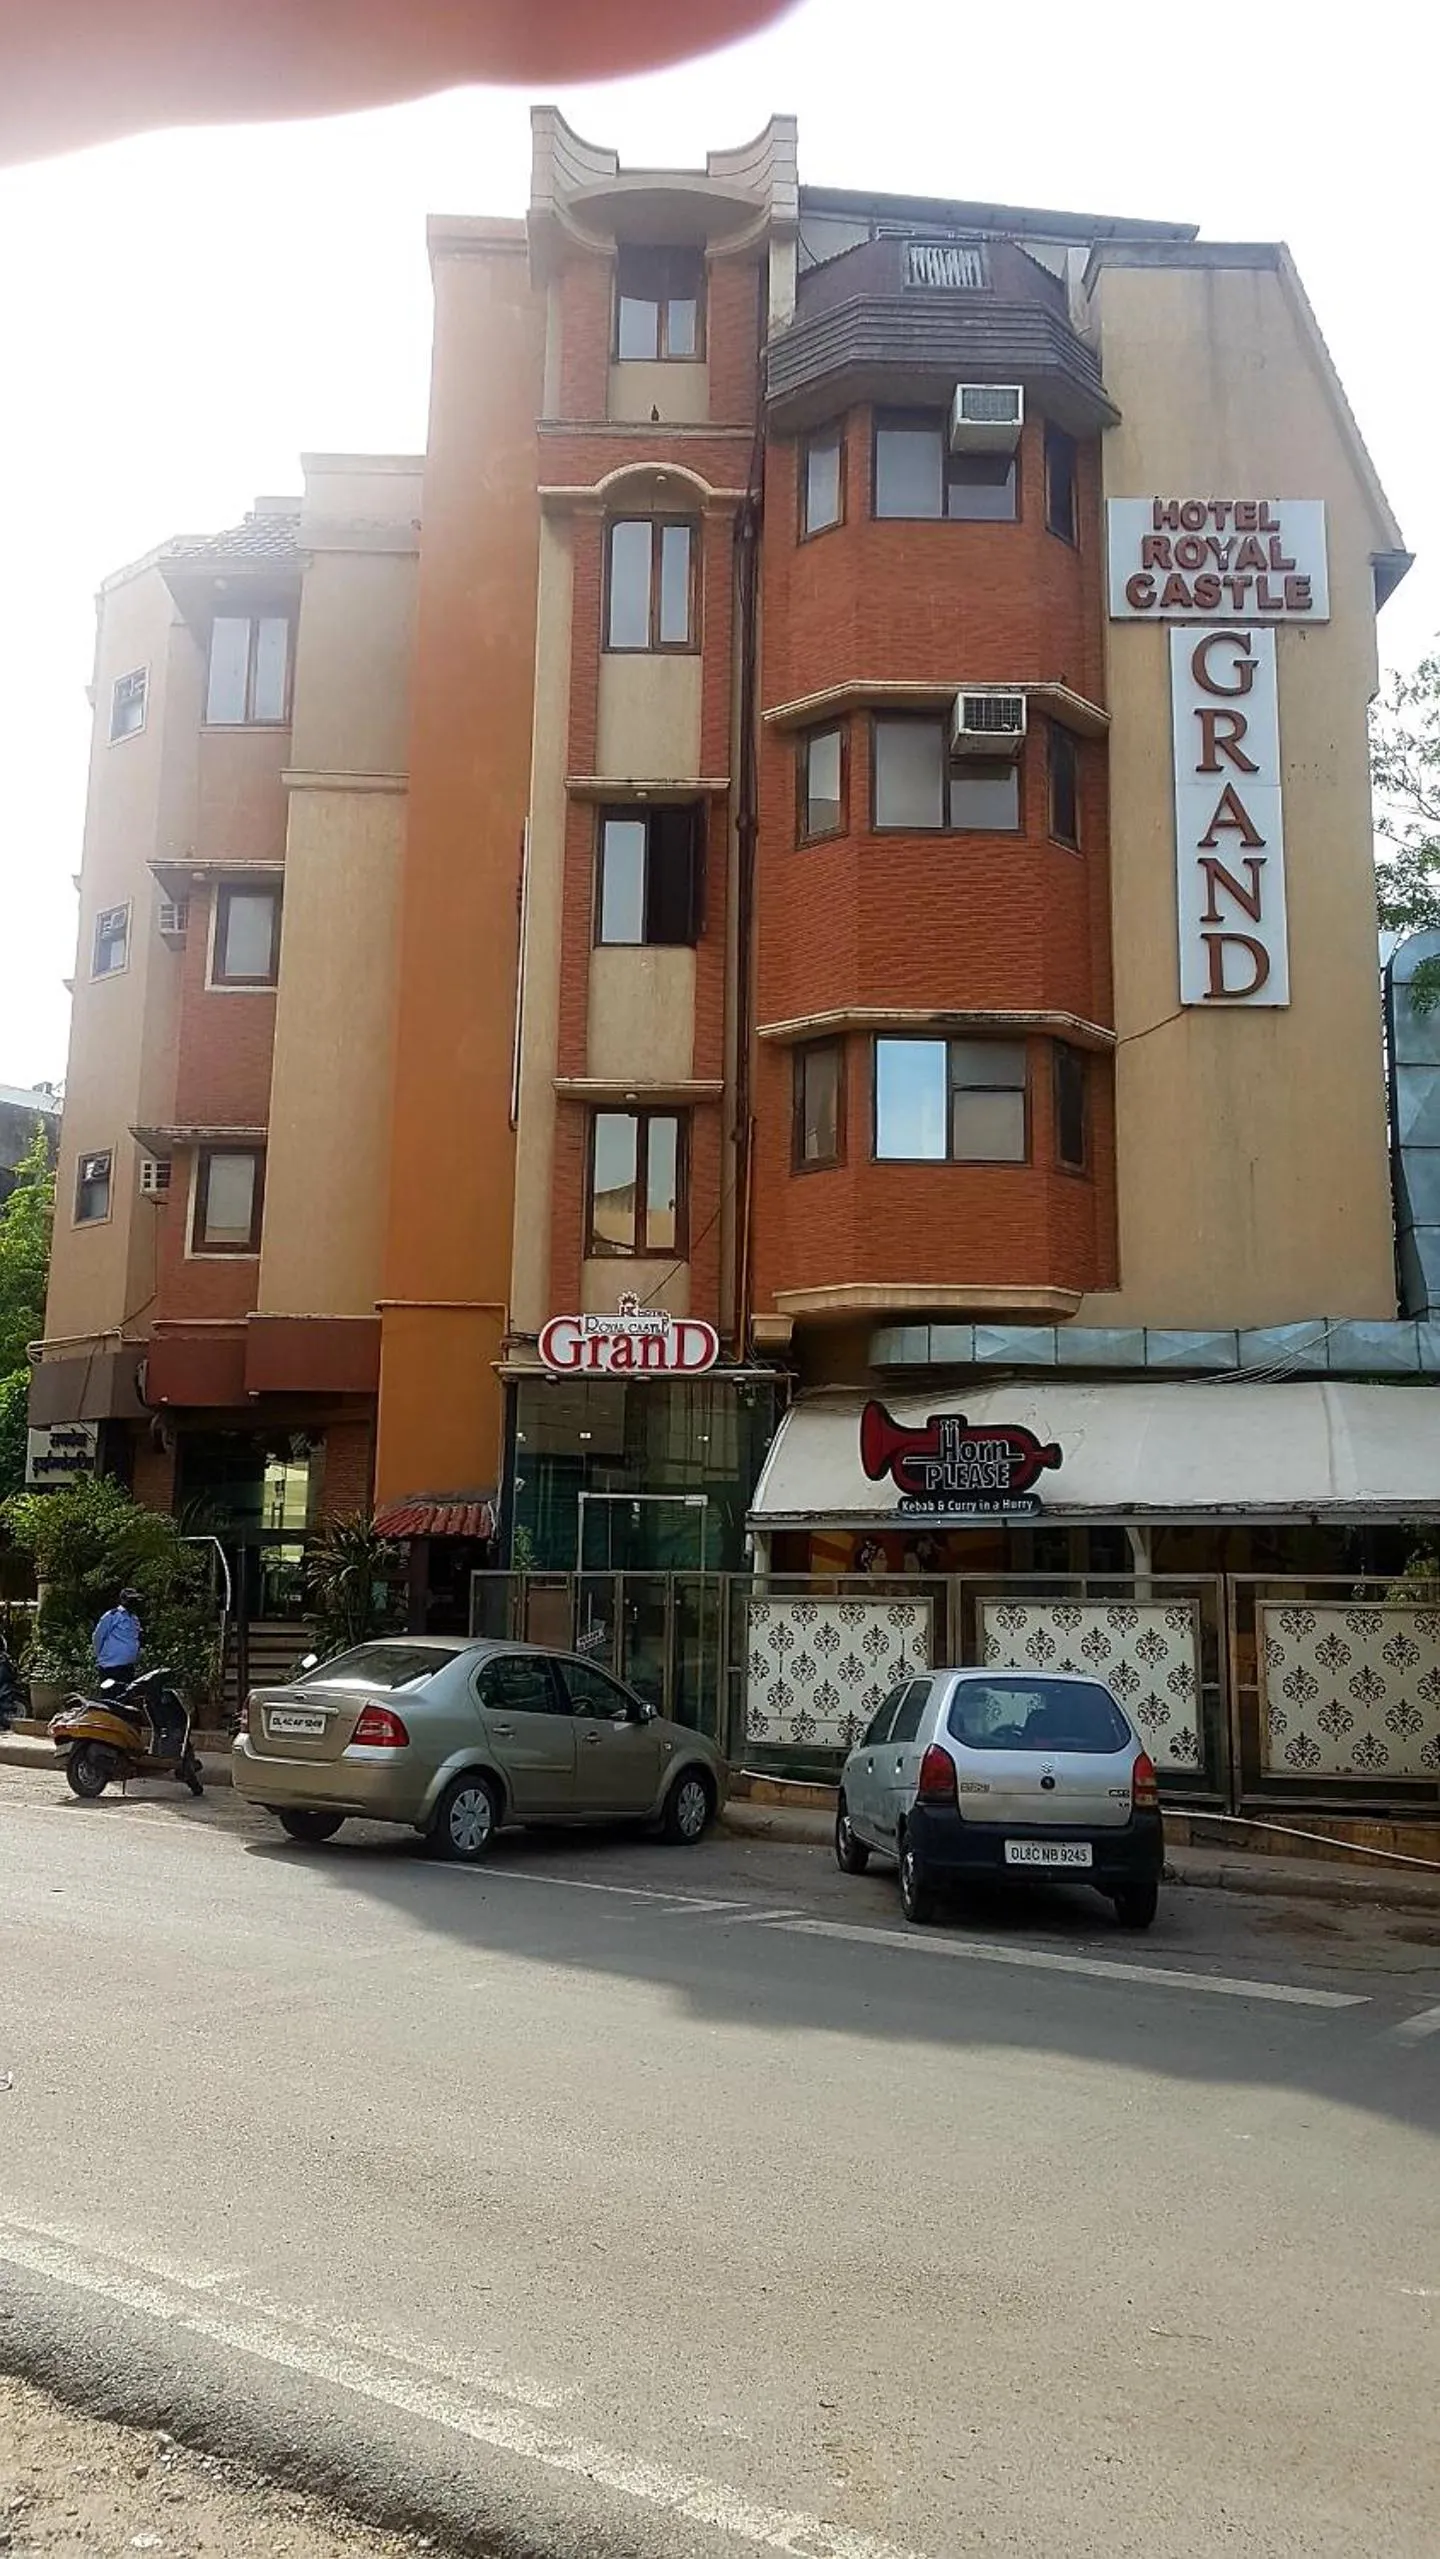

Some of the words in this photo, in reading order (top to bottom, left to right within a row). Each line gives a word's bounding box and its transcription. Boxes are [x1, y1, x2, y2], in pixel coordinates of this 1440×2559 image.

[1152, 501, 1280, 532] HOTEL
[1141, 533, 1296, 570] ROYAL
[1125, 572, 1313, 610] CASTLE
[1191, 631, 1271, 999] GRAND
[925, 1462, 1011, 1490] PLEASE
[902, 1500, 935, 1512] Kebab
[937, 1500, 945, 1511] &
[948, 1499, 977, 1513] Curry
[979, 1499, 991, 1511] in
[993, 1500, 1000, 1511] a
[1002, 1498, 1034, 1511] Hurry
